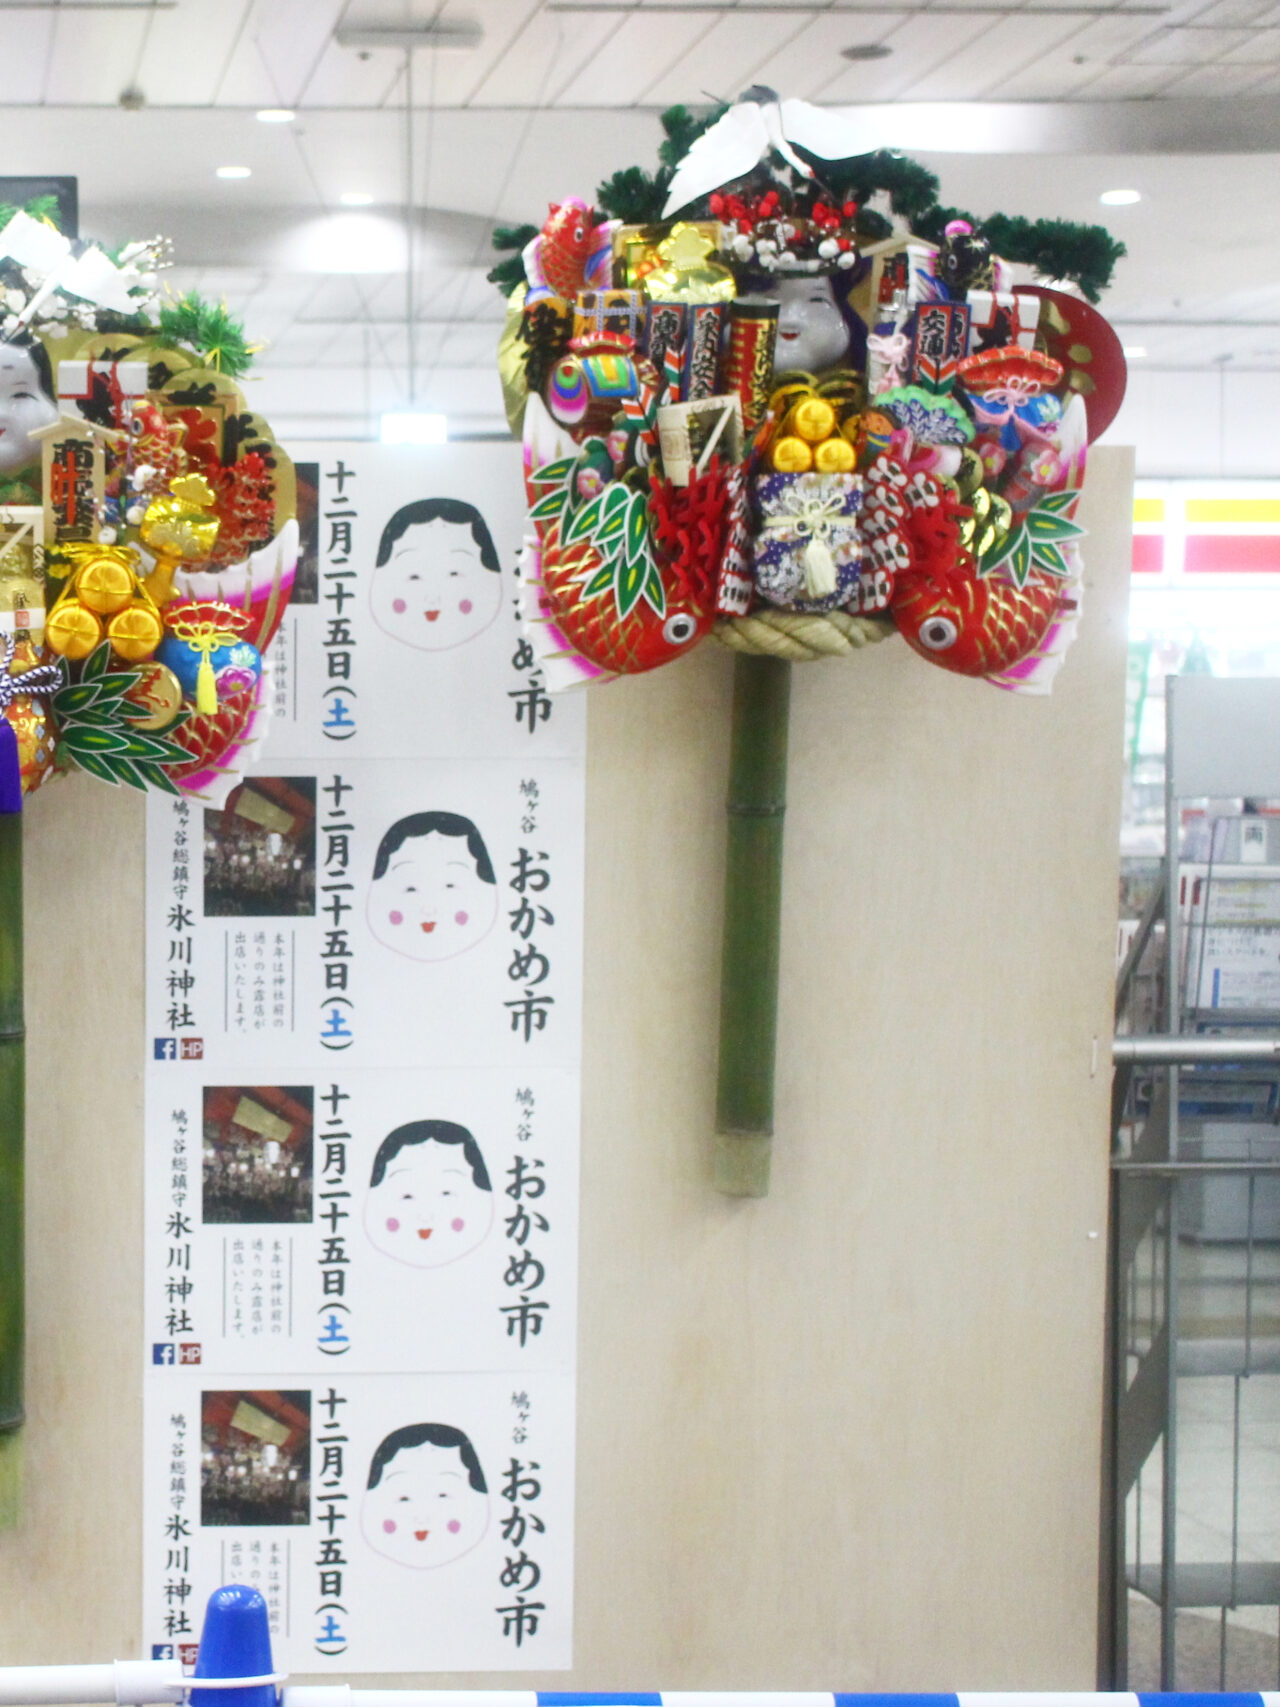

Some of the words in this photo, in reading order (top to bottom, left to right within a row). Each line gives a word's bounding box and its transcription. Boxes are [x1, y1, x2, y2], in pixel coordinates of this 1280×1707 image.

[504, 847, 555, 1043] おかめ市
[499, 1155, 550, 1348] おかめ市
[495, 1457, 546, 1648] おかめ市
